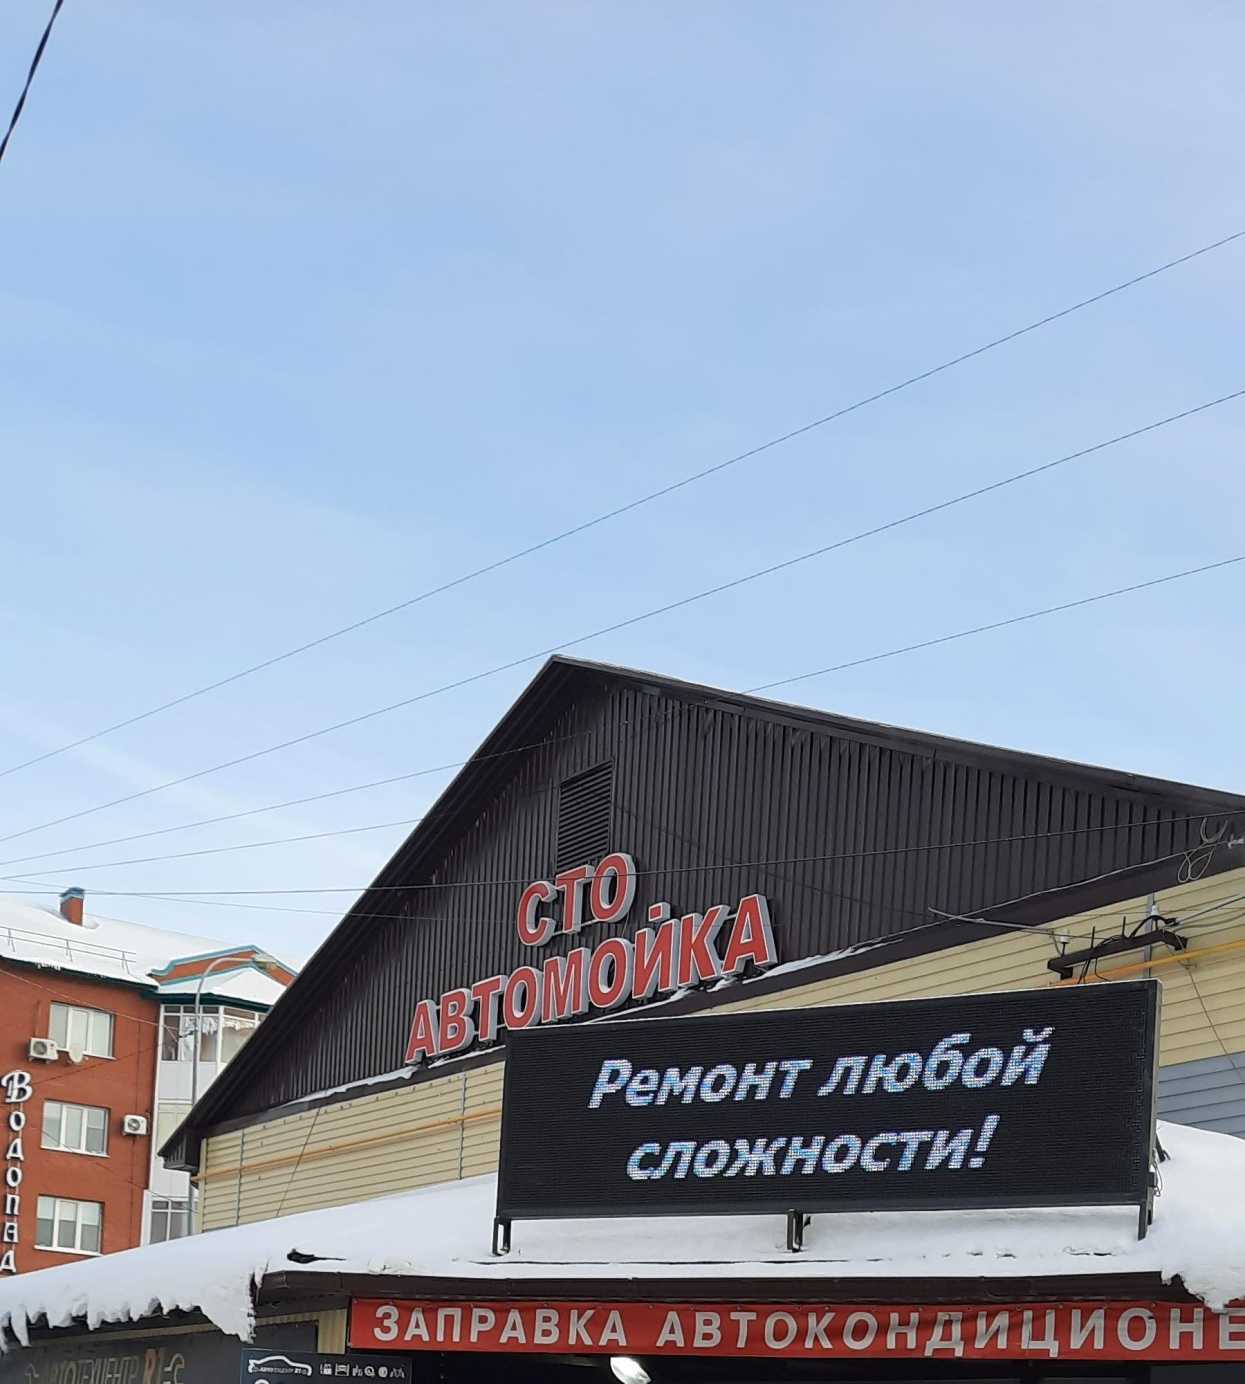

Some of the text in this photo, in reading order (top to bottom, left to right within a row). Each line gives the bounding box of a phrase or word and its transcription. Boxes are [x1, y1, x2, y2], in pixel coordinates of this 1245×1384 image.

[517, 852, 637, 947] СТО
[404, 893, 778, 1065] АВТОМОЙКА
[587, 1027, 1055, 1109] Ремонт любой
[625, 1114, 1001, 1181] сложности!
[373, 1304, 1245, 1358] ЗАПРАВКА АВТОКОНДИЦИОНЕ
